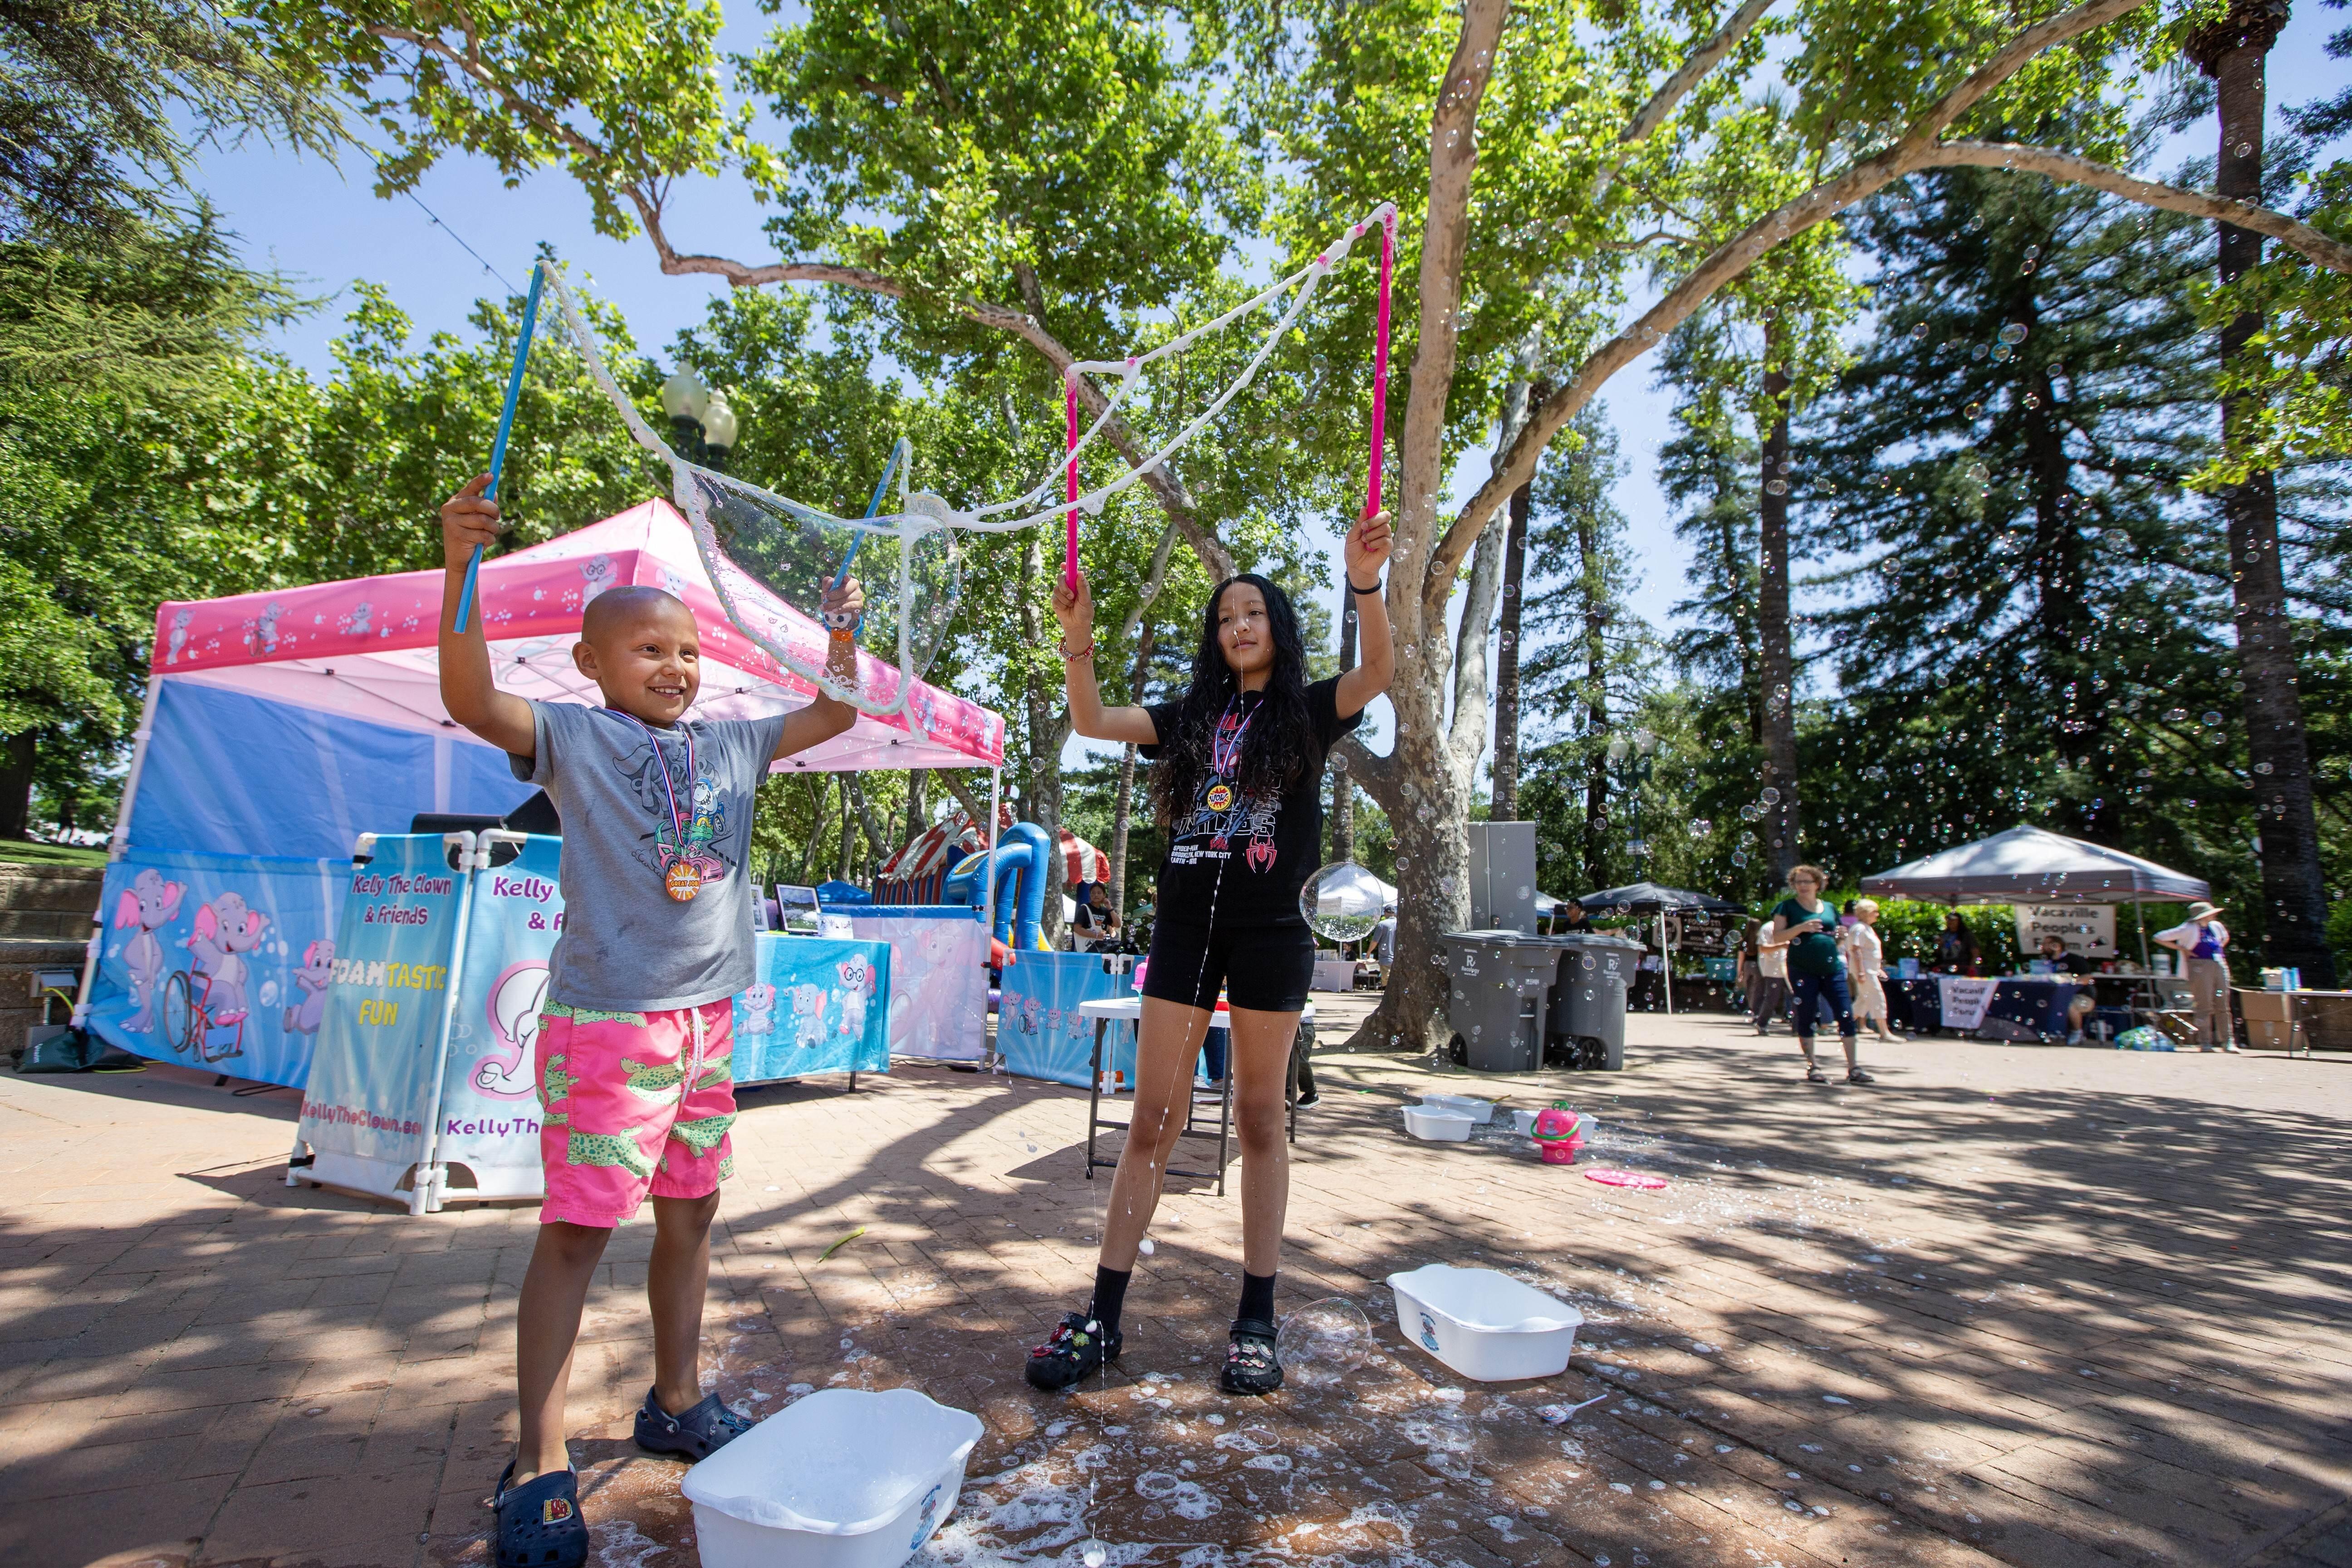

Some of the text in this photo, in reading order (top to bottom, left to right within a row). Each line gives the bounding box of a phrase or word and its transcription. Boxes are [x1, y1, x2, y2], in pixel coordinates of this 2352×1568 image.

[1209, 793, 1229, 803] WOW
[352, 873, 452, 897] Kelly The Clown
[493, 876, 554, 903] Kelly
[528, 912, 545, 930] &
[329, 958, 447, 991] FOAMTASTIC
[358, 999, 399, 1026] FUN
[447, 1118, 539, 1137] KellyTh
